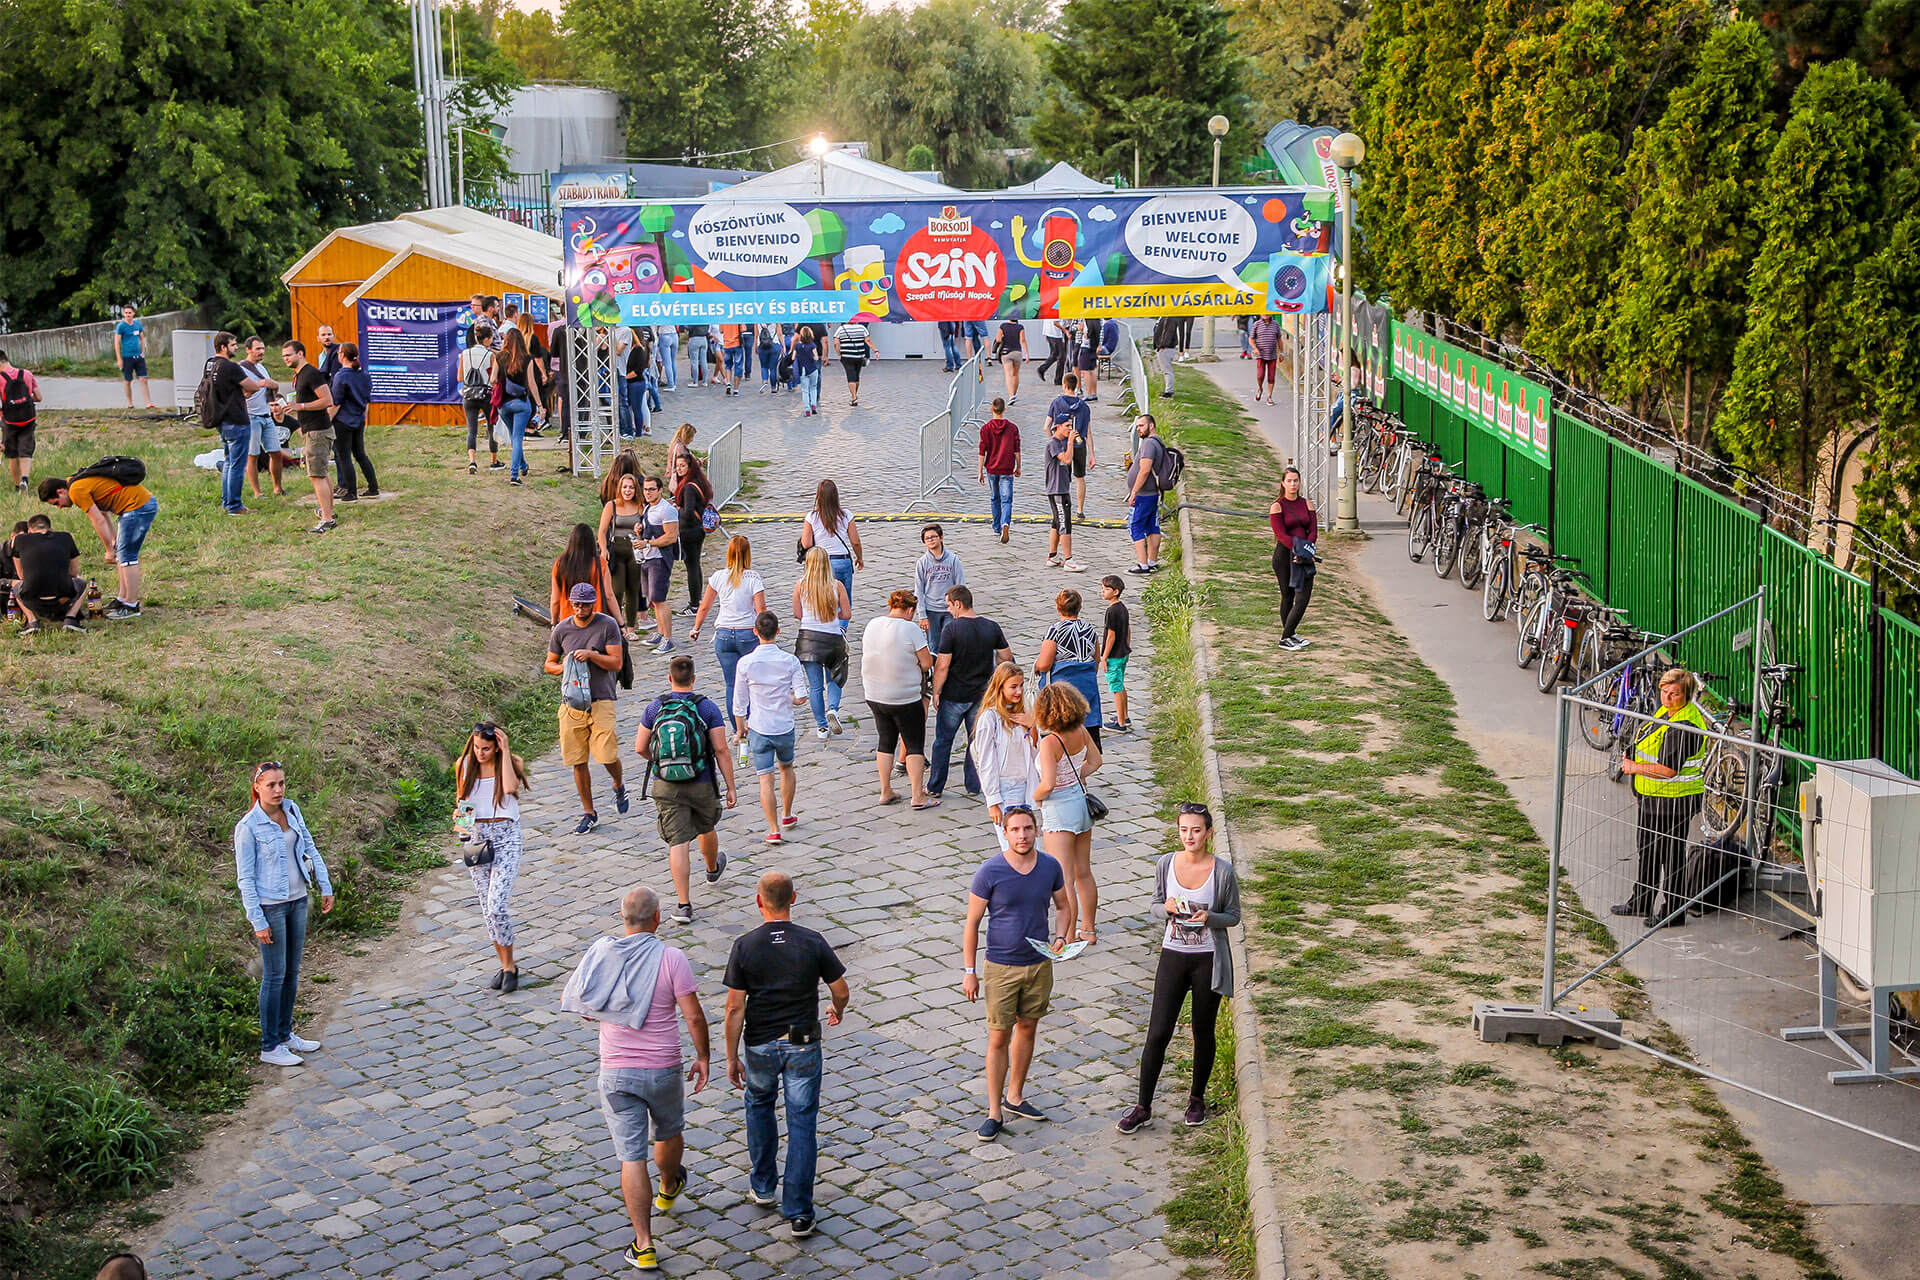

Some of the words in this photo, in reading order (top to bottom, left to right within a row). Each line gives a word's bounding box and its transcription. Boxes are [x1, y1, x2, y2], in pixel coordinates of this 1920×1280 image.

[558, 186, 620, 200] SZABADSTRAND
[694, 212, 785, 235] KÖSZÖNTÜNK
[1141, 208, 1227, 227] BIENVENUE
[930, 221, 969, 232] BORSODI
[716, 233, 800, 247] BIENVENIDO
[1166, 231, 1240, 245] WELCOME
[708, 251, 788, 265] WILLKOMMEN
[1144, 245, 1227, 263] BENVENUTO
[905, 291, 936, 301] Szegedi
[968, 291, 995, 301] Napok
[1083, 292, 1165, 309] HELYSZÍNI
[1170, 290, 1254, 306] VÁSÁRLÁS
[367, 306, 438, 321] CHECK-IN
[631, 300, 725, 317] ELŐVÉTELES
[728, 302, 764, 318] JEGY
[768, 299, 785, 315] ÉS
[790, 298, 845, 314] BÉRLET
